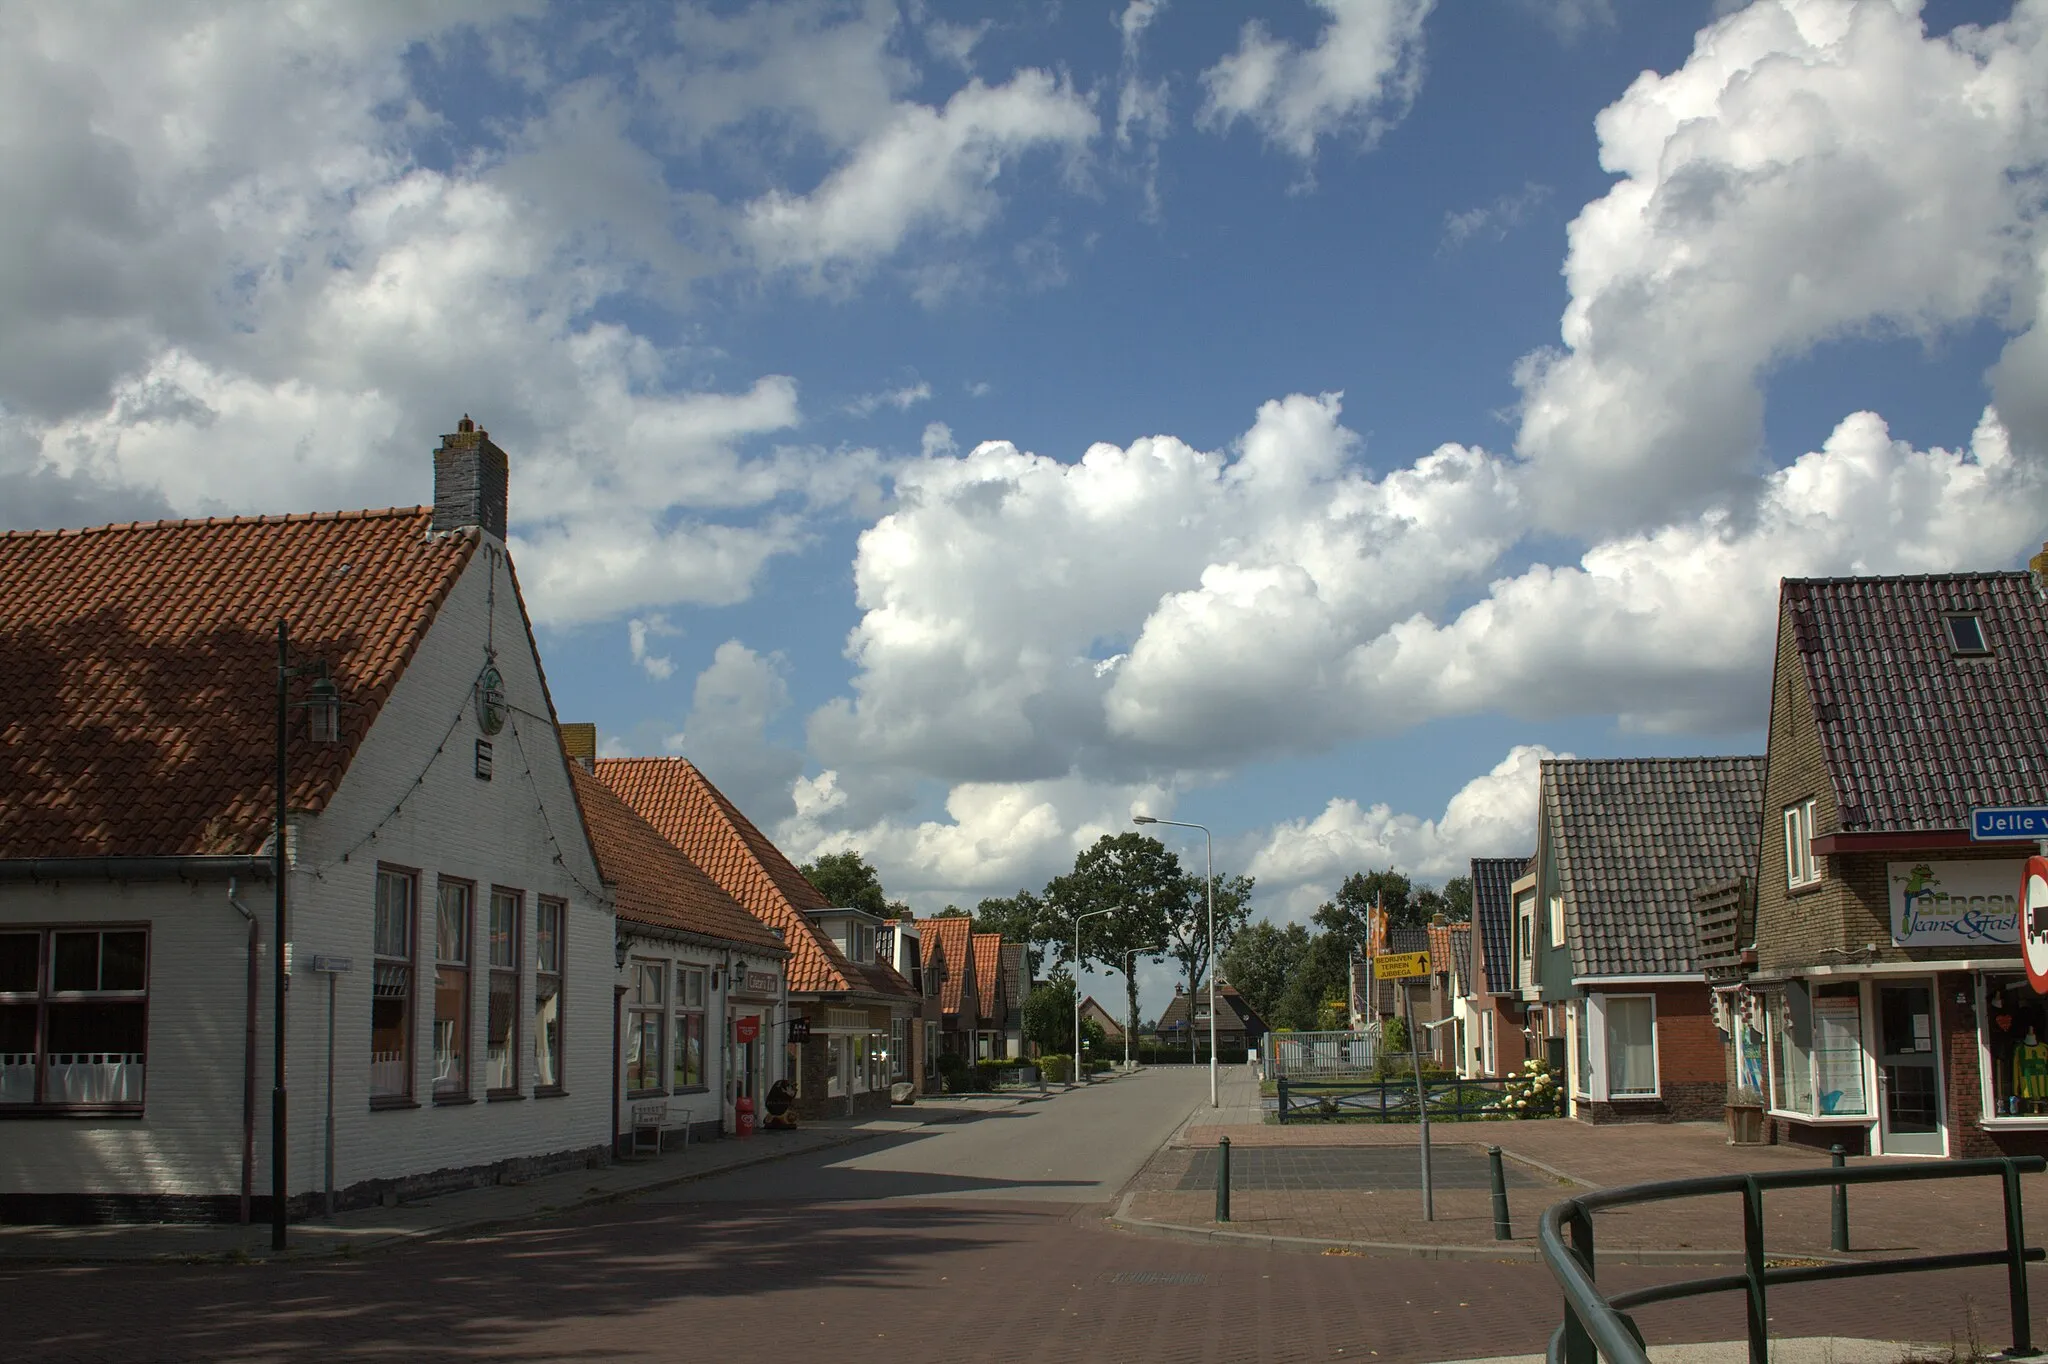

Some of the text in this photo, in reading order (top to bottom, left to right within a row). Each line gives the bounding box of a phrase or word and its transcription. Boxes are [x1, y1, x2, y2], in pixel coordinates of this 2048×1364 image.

[1981, 815, 2034, 831] Jelle
[1376, 954, 1412, 963] BEDRIJVEN
[1382, 962, 1409, 970] TERREIN
